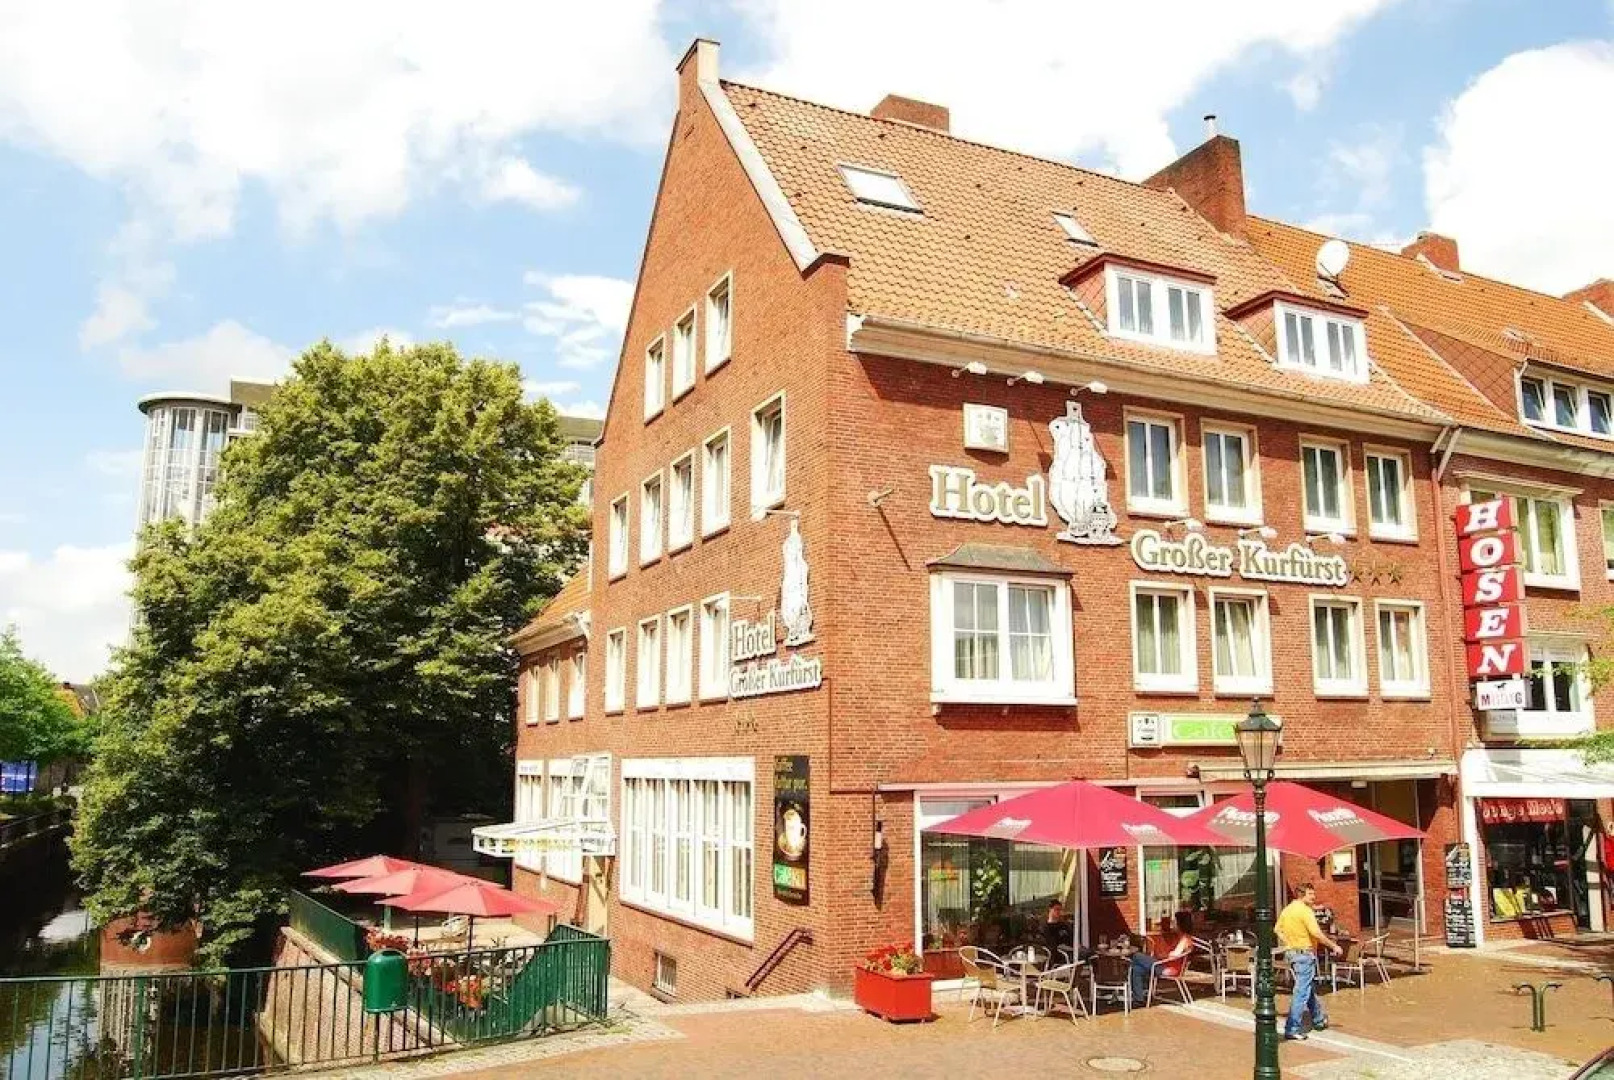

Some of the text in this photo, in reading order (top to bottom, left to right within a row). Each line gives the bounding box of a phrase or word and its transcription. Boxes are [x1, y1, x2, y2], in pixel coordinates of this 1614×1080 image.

[933, 469, 1044, 523] Hotel
[1134, 533, 1345, 583] Großer Kurfürst
[1463, 499, 1517, 674] HOSEN
[732, 612, 775, 658] Hotel
[730, 659, 820, 694] Großer Kurfürst
